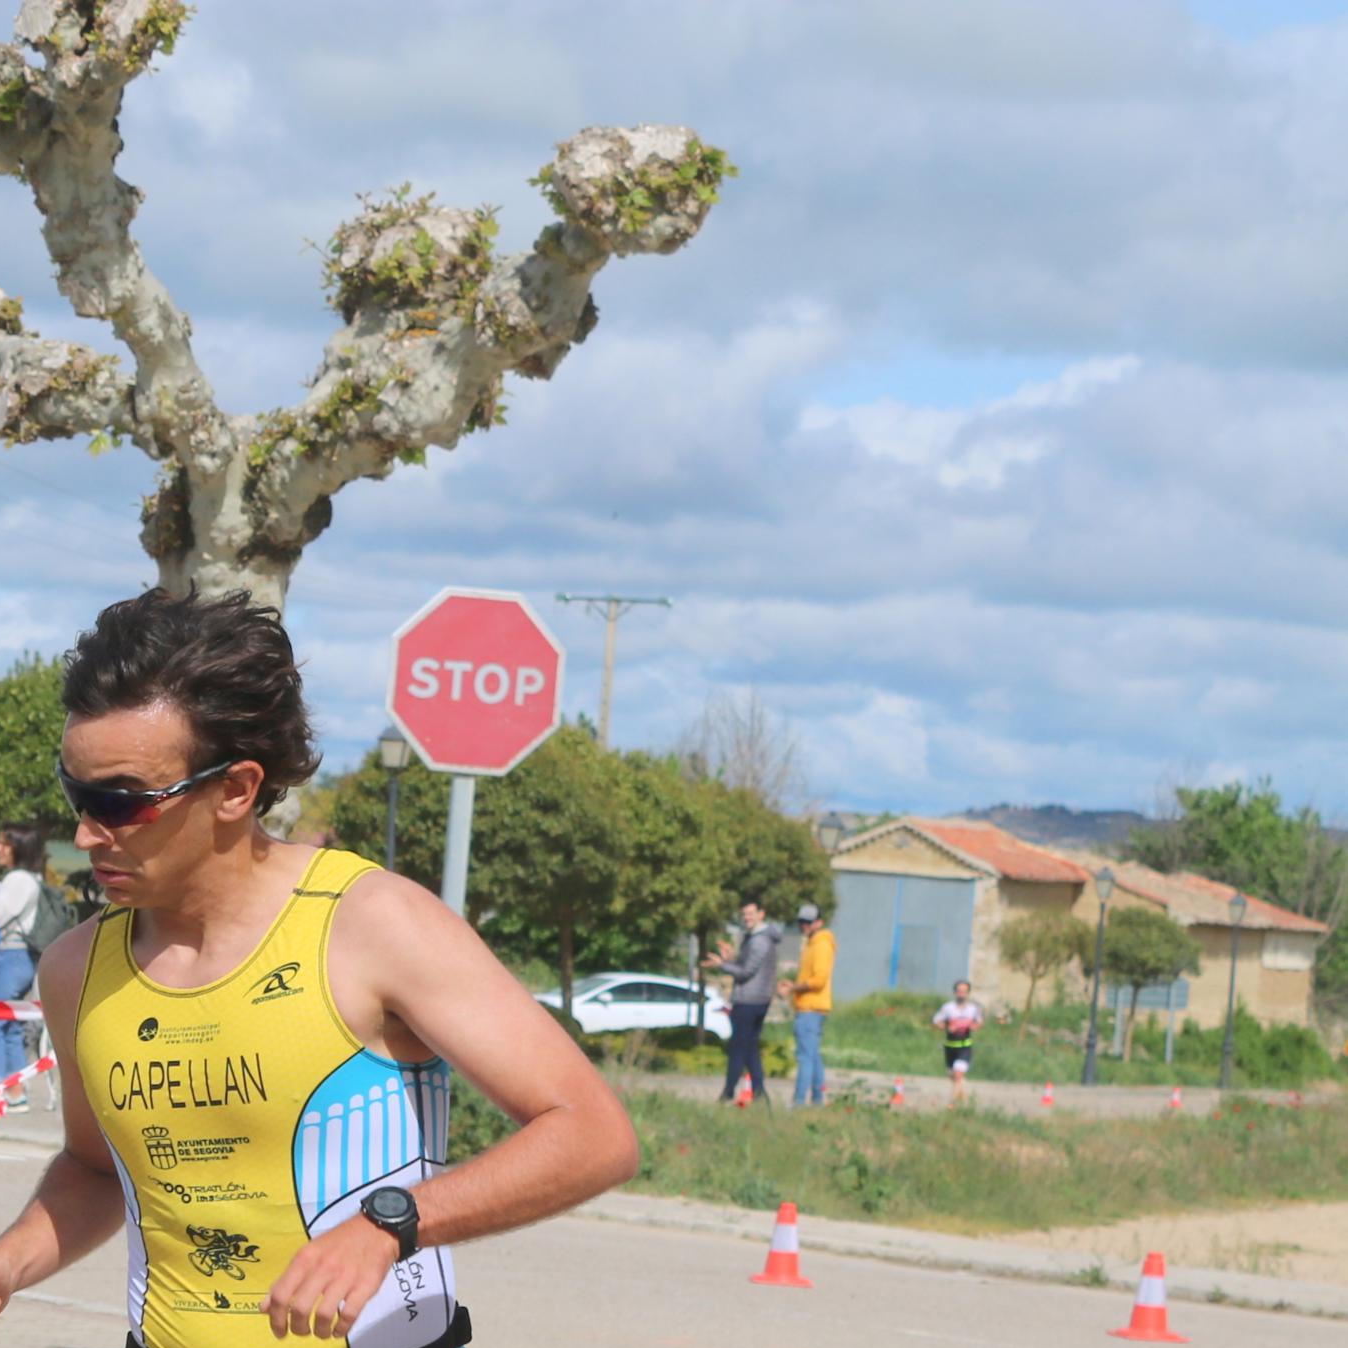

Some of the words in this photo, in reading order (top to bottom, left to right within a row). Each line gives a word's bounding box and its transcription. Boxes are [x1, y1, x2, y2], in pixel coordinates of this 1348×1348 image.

[407, 657, 546, 706] STOP
[109, 1053, 268, 1111] CAPELLAN
[177, 1136, 250, 1148] AYUNTAMIENTO
[178, 1148, 191, 1156] DE
[193, 1146, 236, 1155] SEGOVIA
